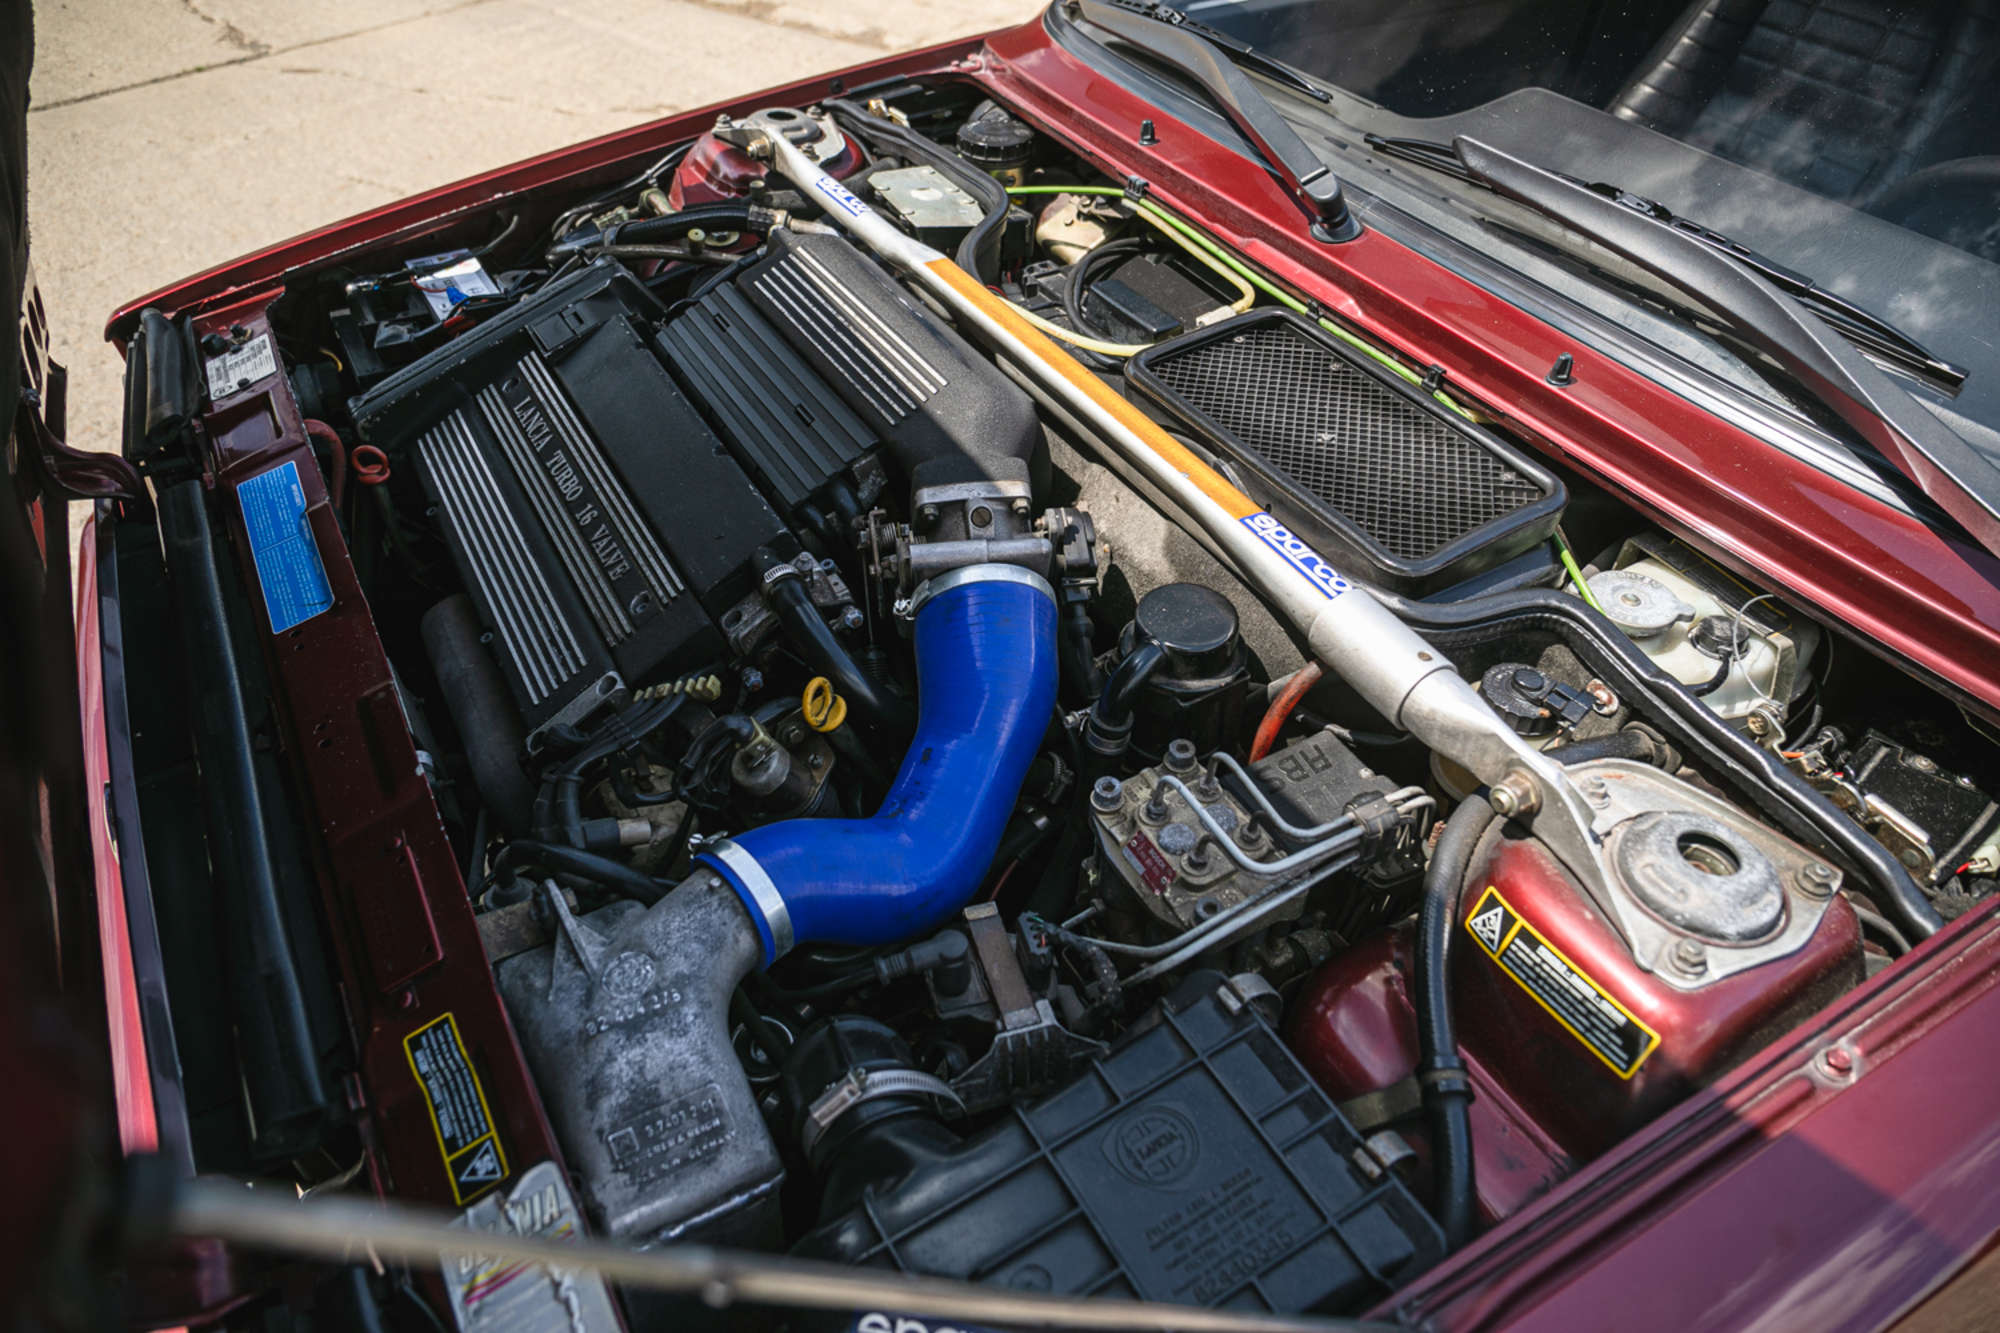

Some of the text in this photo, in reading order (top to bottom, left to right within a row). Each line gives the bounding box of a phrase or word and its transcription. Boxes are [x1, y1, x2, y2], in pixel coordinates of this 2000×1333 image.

[513, 396, 631, 581] LANCIA TURBO 16 VALVE
[1243, 513, 1352, 597] sparco
